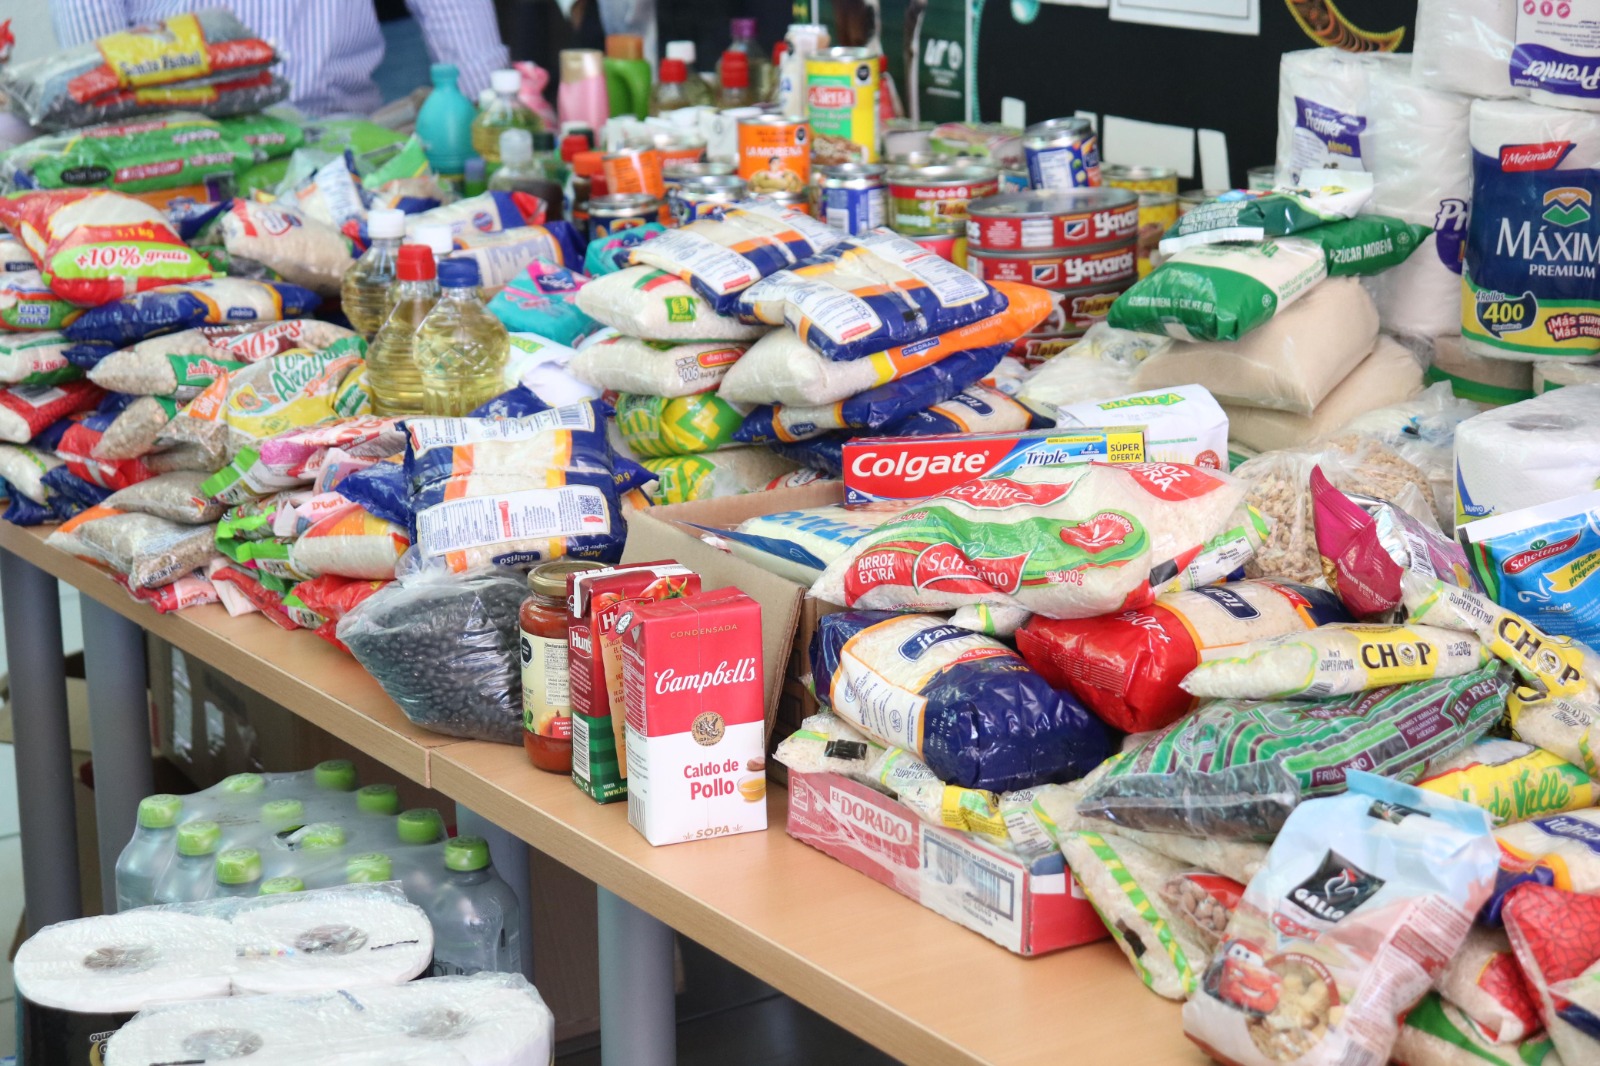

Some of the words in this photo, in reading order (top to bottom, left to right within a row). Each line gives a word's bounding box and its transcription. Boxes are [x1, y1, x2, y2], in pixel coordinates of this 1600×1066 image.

[1523, 59, 1600, 90] Premier
[1305, 107, 1346, 138] Premier
[1501, 146, 1561, 167] ¡Mejorado!
[77, 246, 142, 268] +10%
[145, 249, 190, 266] gratis
[1529, 263, 1596, 279] PREMIUM
[18, 303, 51, 316] Extra
[1483, 302, 1525, 323] 400
[1554, 326, 1578, 340] Más
[1100, 392, 1184, 411] MASECA
[1110, 441, 1140, 452] SÚPER
[851, 450, 986, 483] Colgate
[1027, 450, 1068, 466] Triple
[1464, 504, 1485, 513] Nuevo
[499, 553, 534, 566] italriso
[857, 552, 895, 572] ARROZ
[1510, 543, 1568, 571] Schettino
[858, 565, 896, 584] EXTRA
[1058, 570, 1085, 587] 900g
[669, 623, 739, 640] CONDENSADA
[653, 657, 757, 695] Campbell's
[683, 759, 721, 779] Caldo
[722, 758, 739, 774] de
[1315, 765, 1344, 783] FRIJO
[690, 778, 735, 801] Pollo
[1512, 768, 1571, 818] Valle
[832, 790, 841, 803] EL
[841, 796, 908, 844] DORADO
[695, 824, 730, 839] SOPA
[1294, 888, 1346, 921] GALLO
